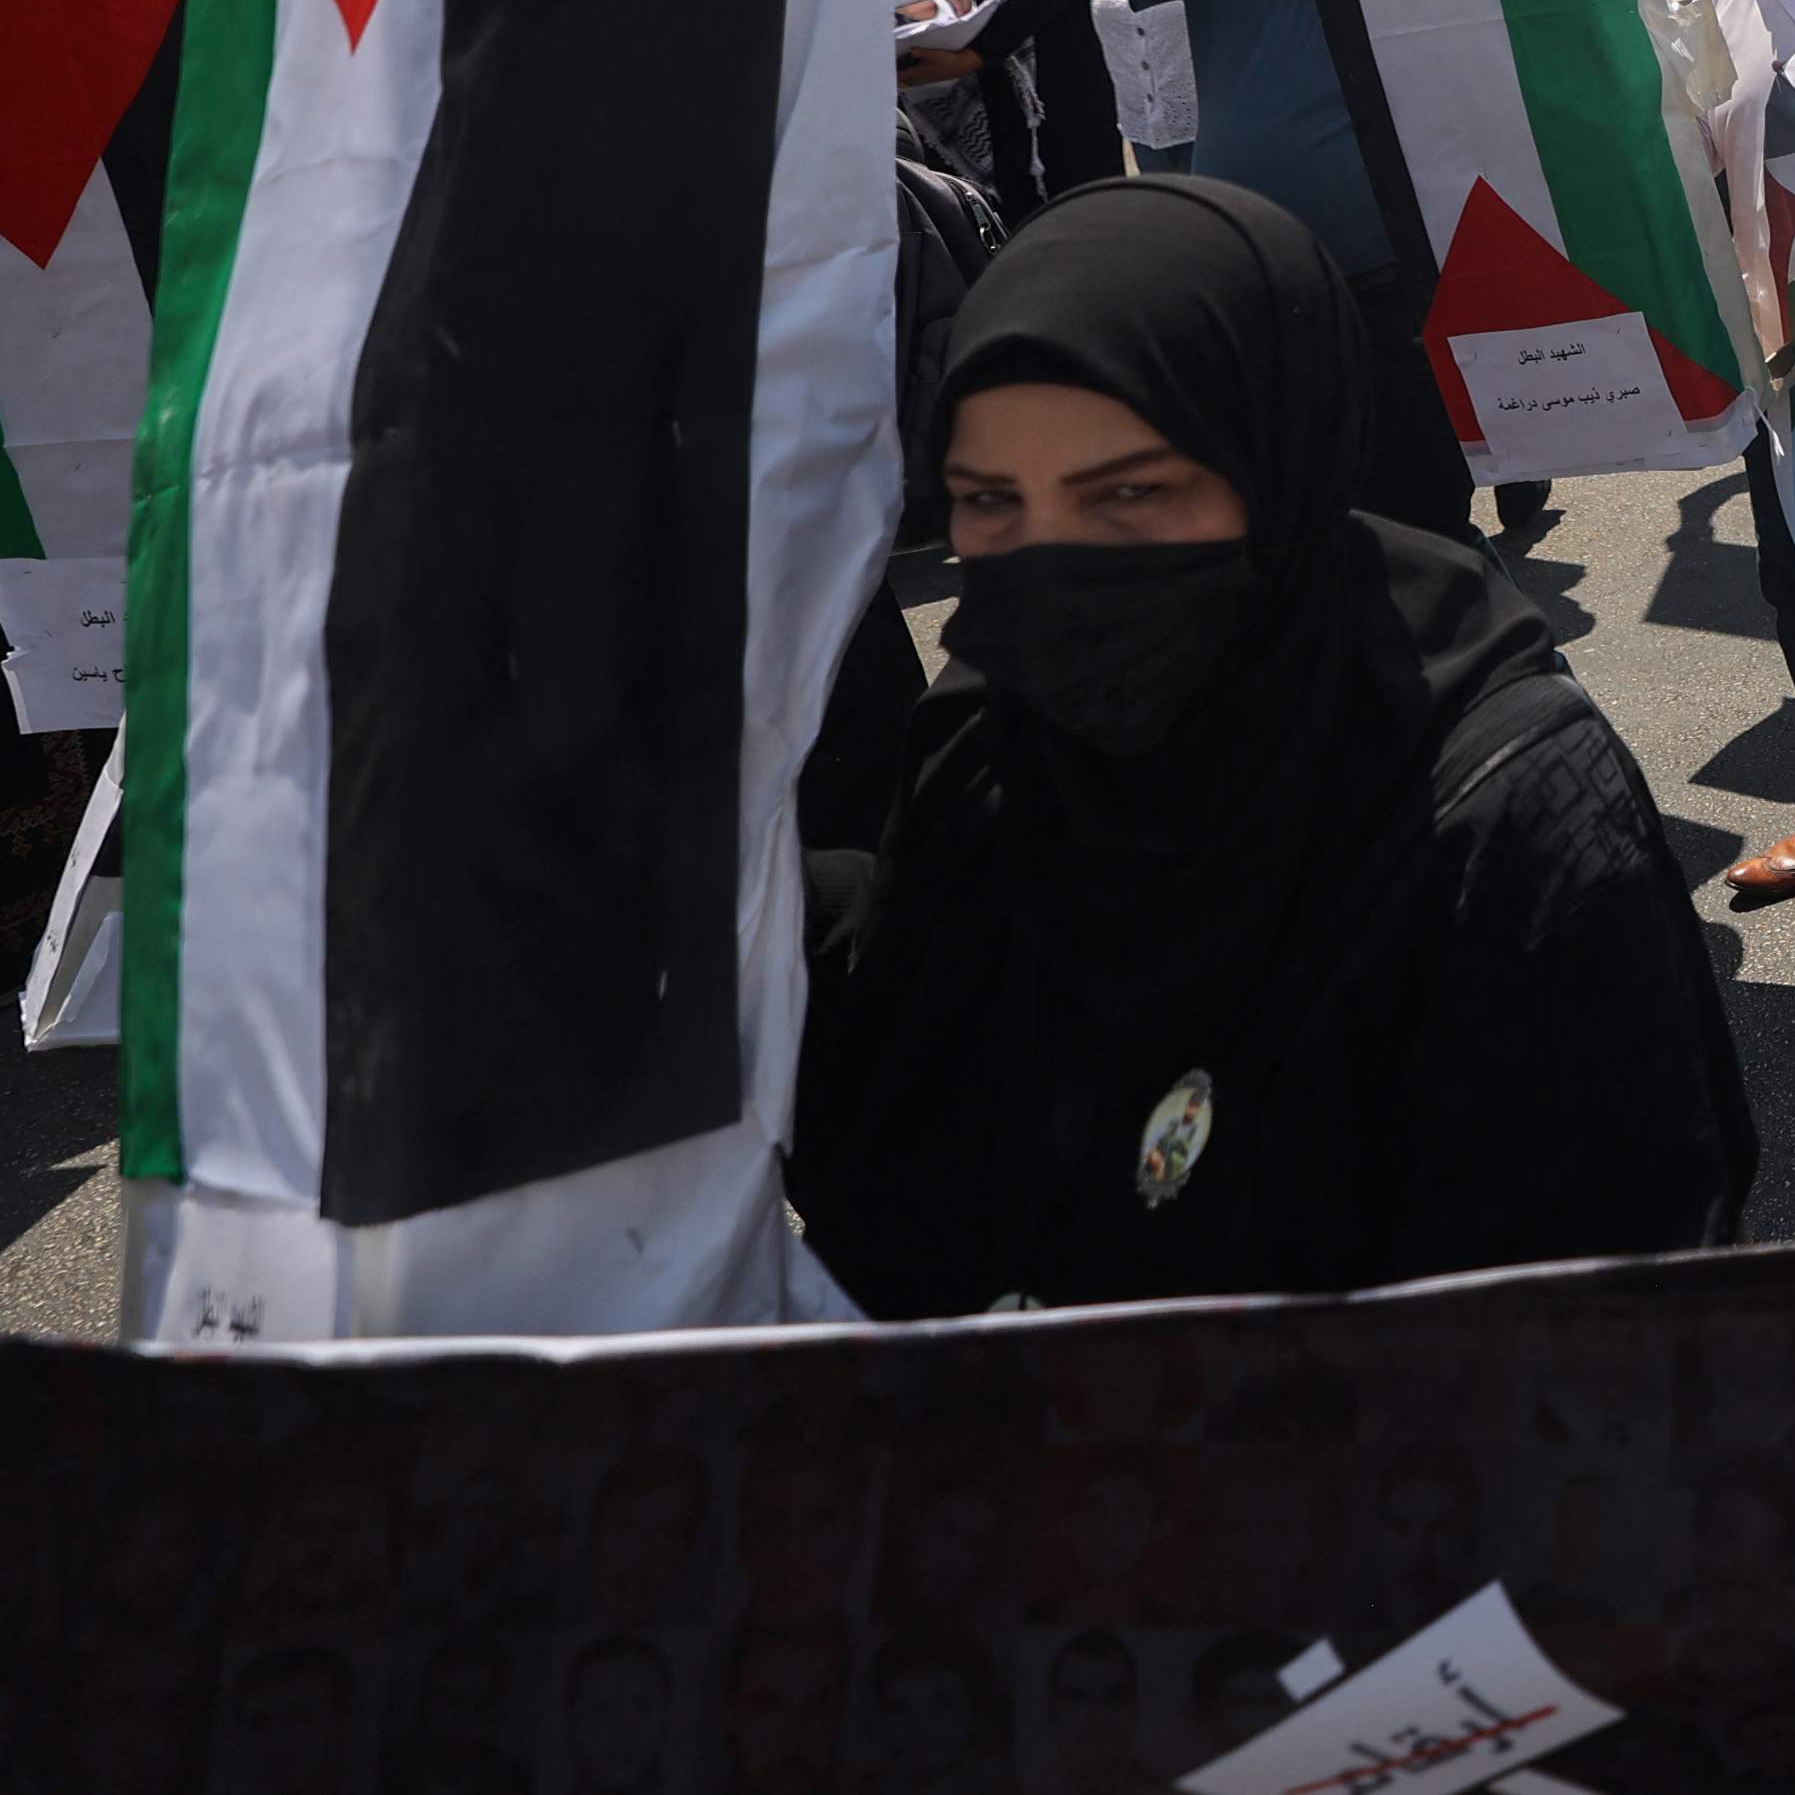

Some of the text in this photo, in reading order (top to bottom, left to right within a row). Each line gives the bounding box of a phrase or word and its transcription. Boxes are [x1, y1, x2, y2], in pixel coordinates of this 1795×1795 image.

[1518, 342, 1586, 365] الشهيد البطل
[1498, 385, 1641, 412] صبري ذيب موسى دراغمة
[79, 609, 116, 629] البطل
[72, 665, 110, 683] ياسين
